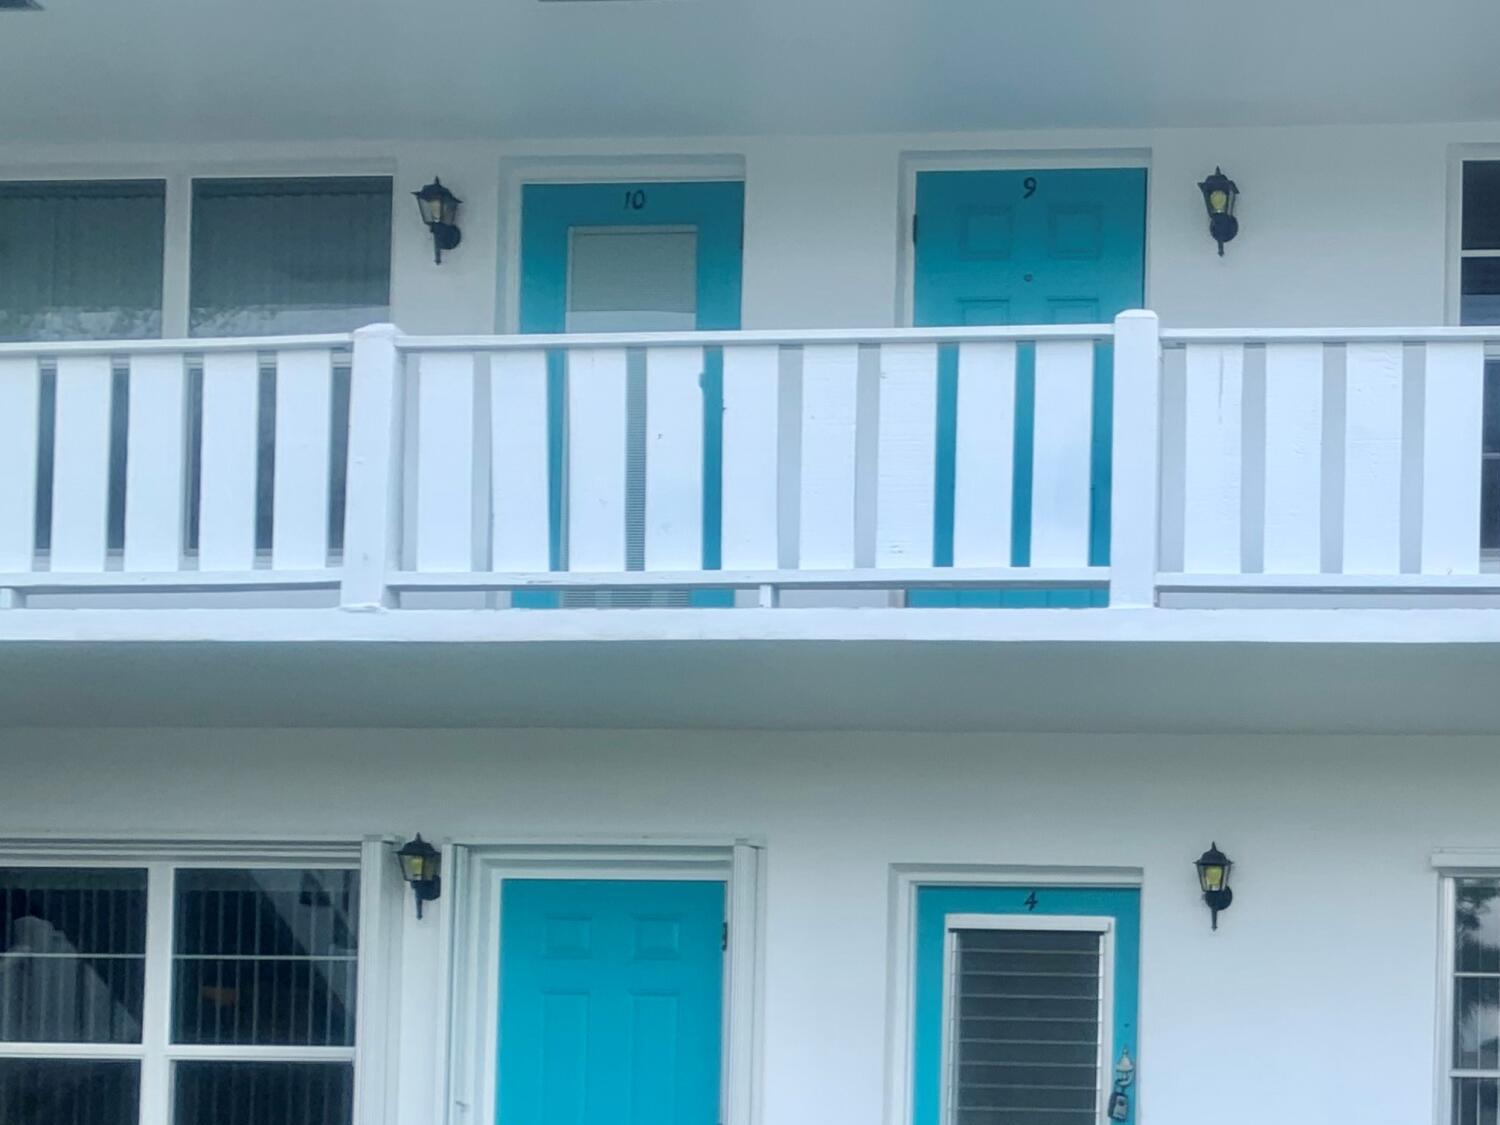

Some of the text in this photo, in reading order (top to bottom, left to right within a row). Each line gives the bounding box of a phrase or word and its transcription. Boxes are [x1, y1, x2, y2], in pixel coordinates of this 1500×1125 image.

[1023, 177, 1037, 199] 9
[624, 189, 646, 210] 10
[1024, 888, 1038, 911] 4
